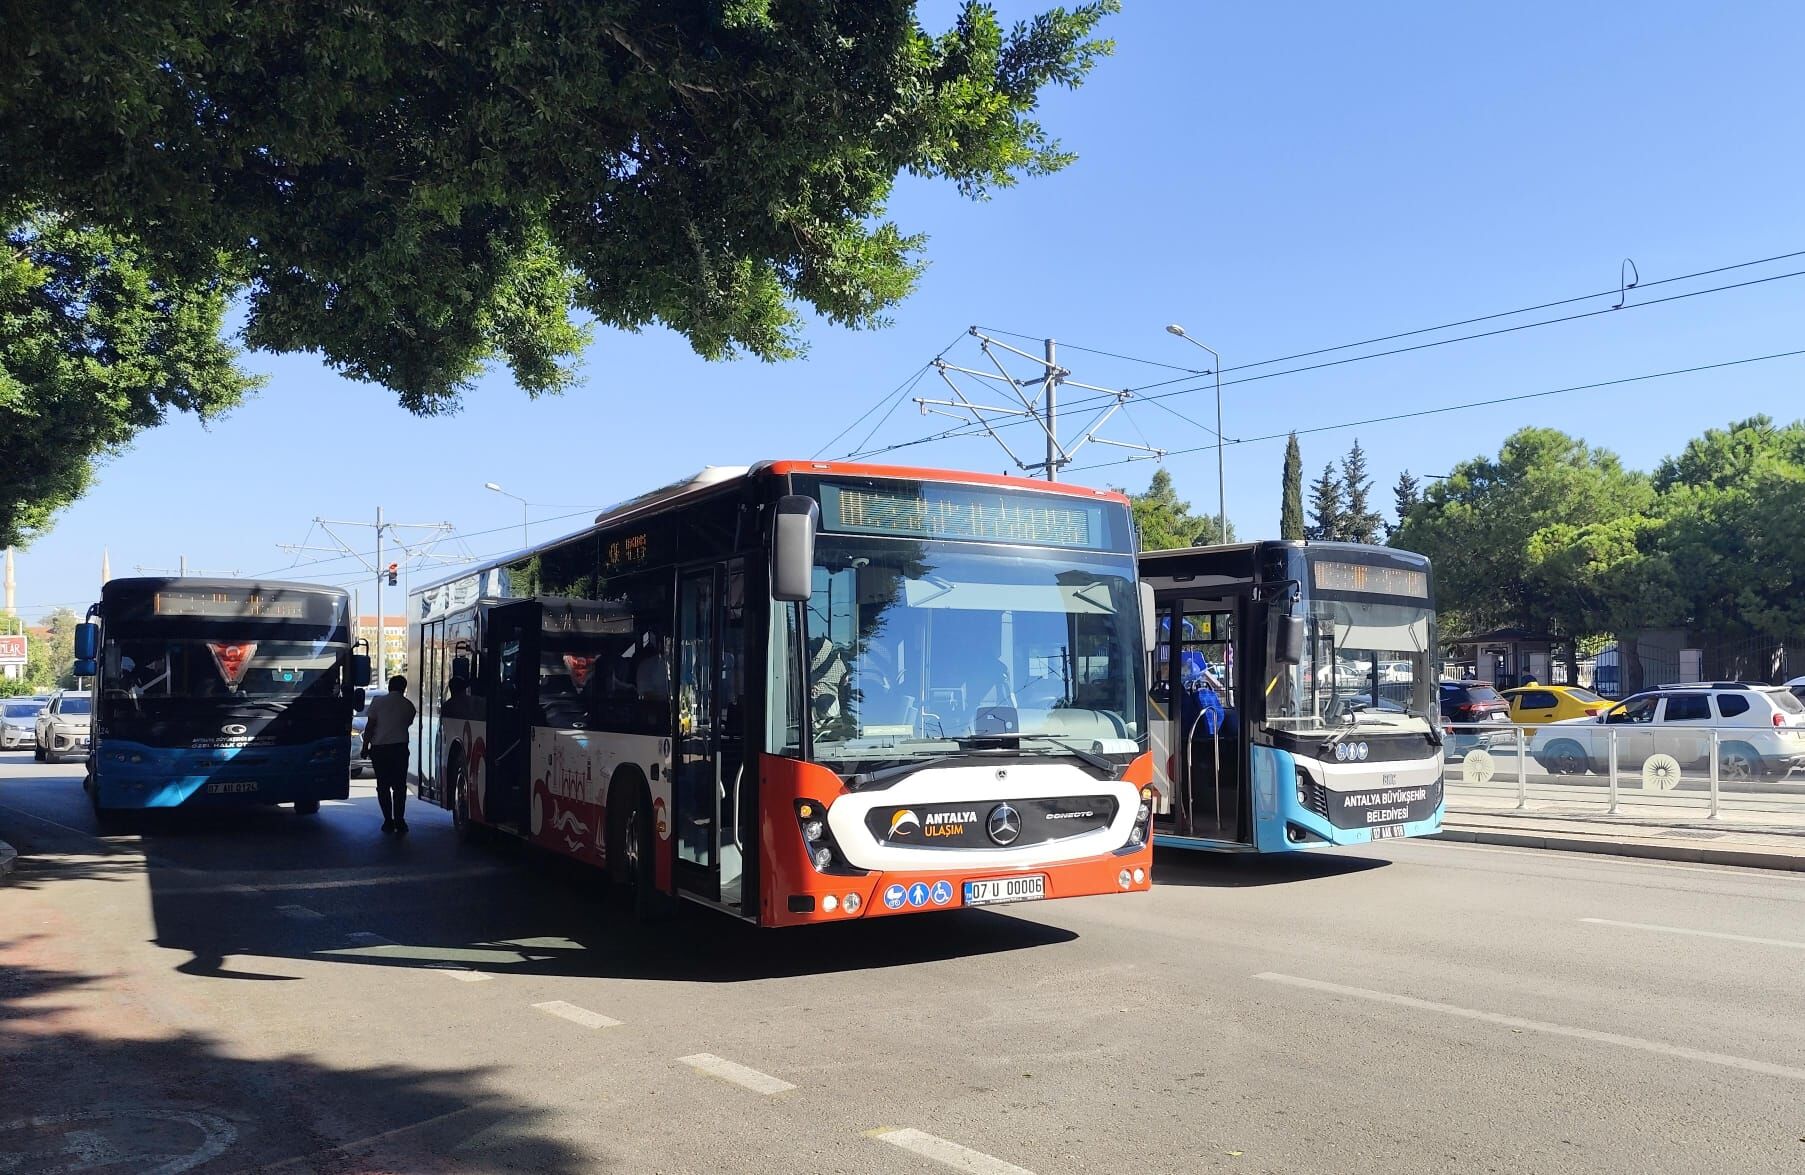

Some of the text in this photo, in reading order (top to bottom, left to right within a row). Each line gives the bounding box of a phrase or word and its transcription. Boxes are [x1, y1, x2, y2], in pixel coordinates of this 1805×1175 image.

[1344, 788, 1426, 807] ANTALYA BÜYÜKŞEHİR
[925, 811, 977, 825] ANTALYA
[1046, 811, 1093, 820] CONECTO
[1367, 806, 1409, 822] BELEDİYESİ
[925, 825, 963, 837] ULAŞIM
[973, 884, 987, 899] 07
[992, 882, 999, 897] U
[1007, 879, 1042, 895] 00006
